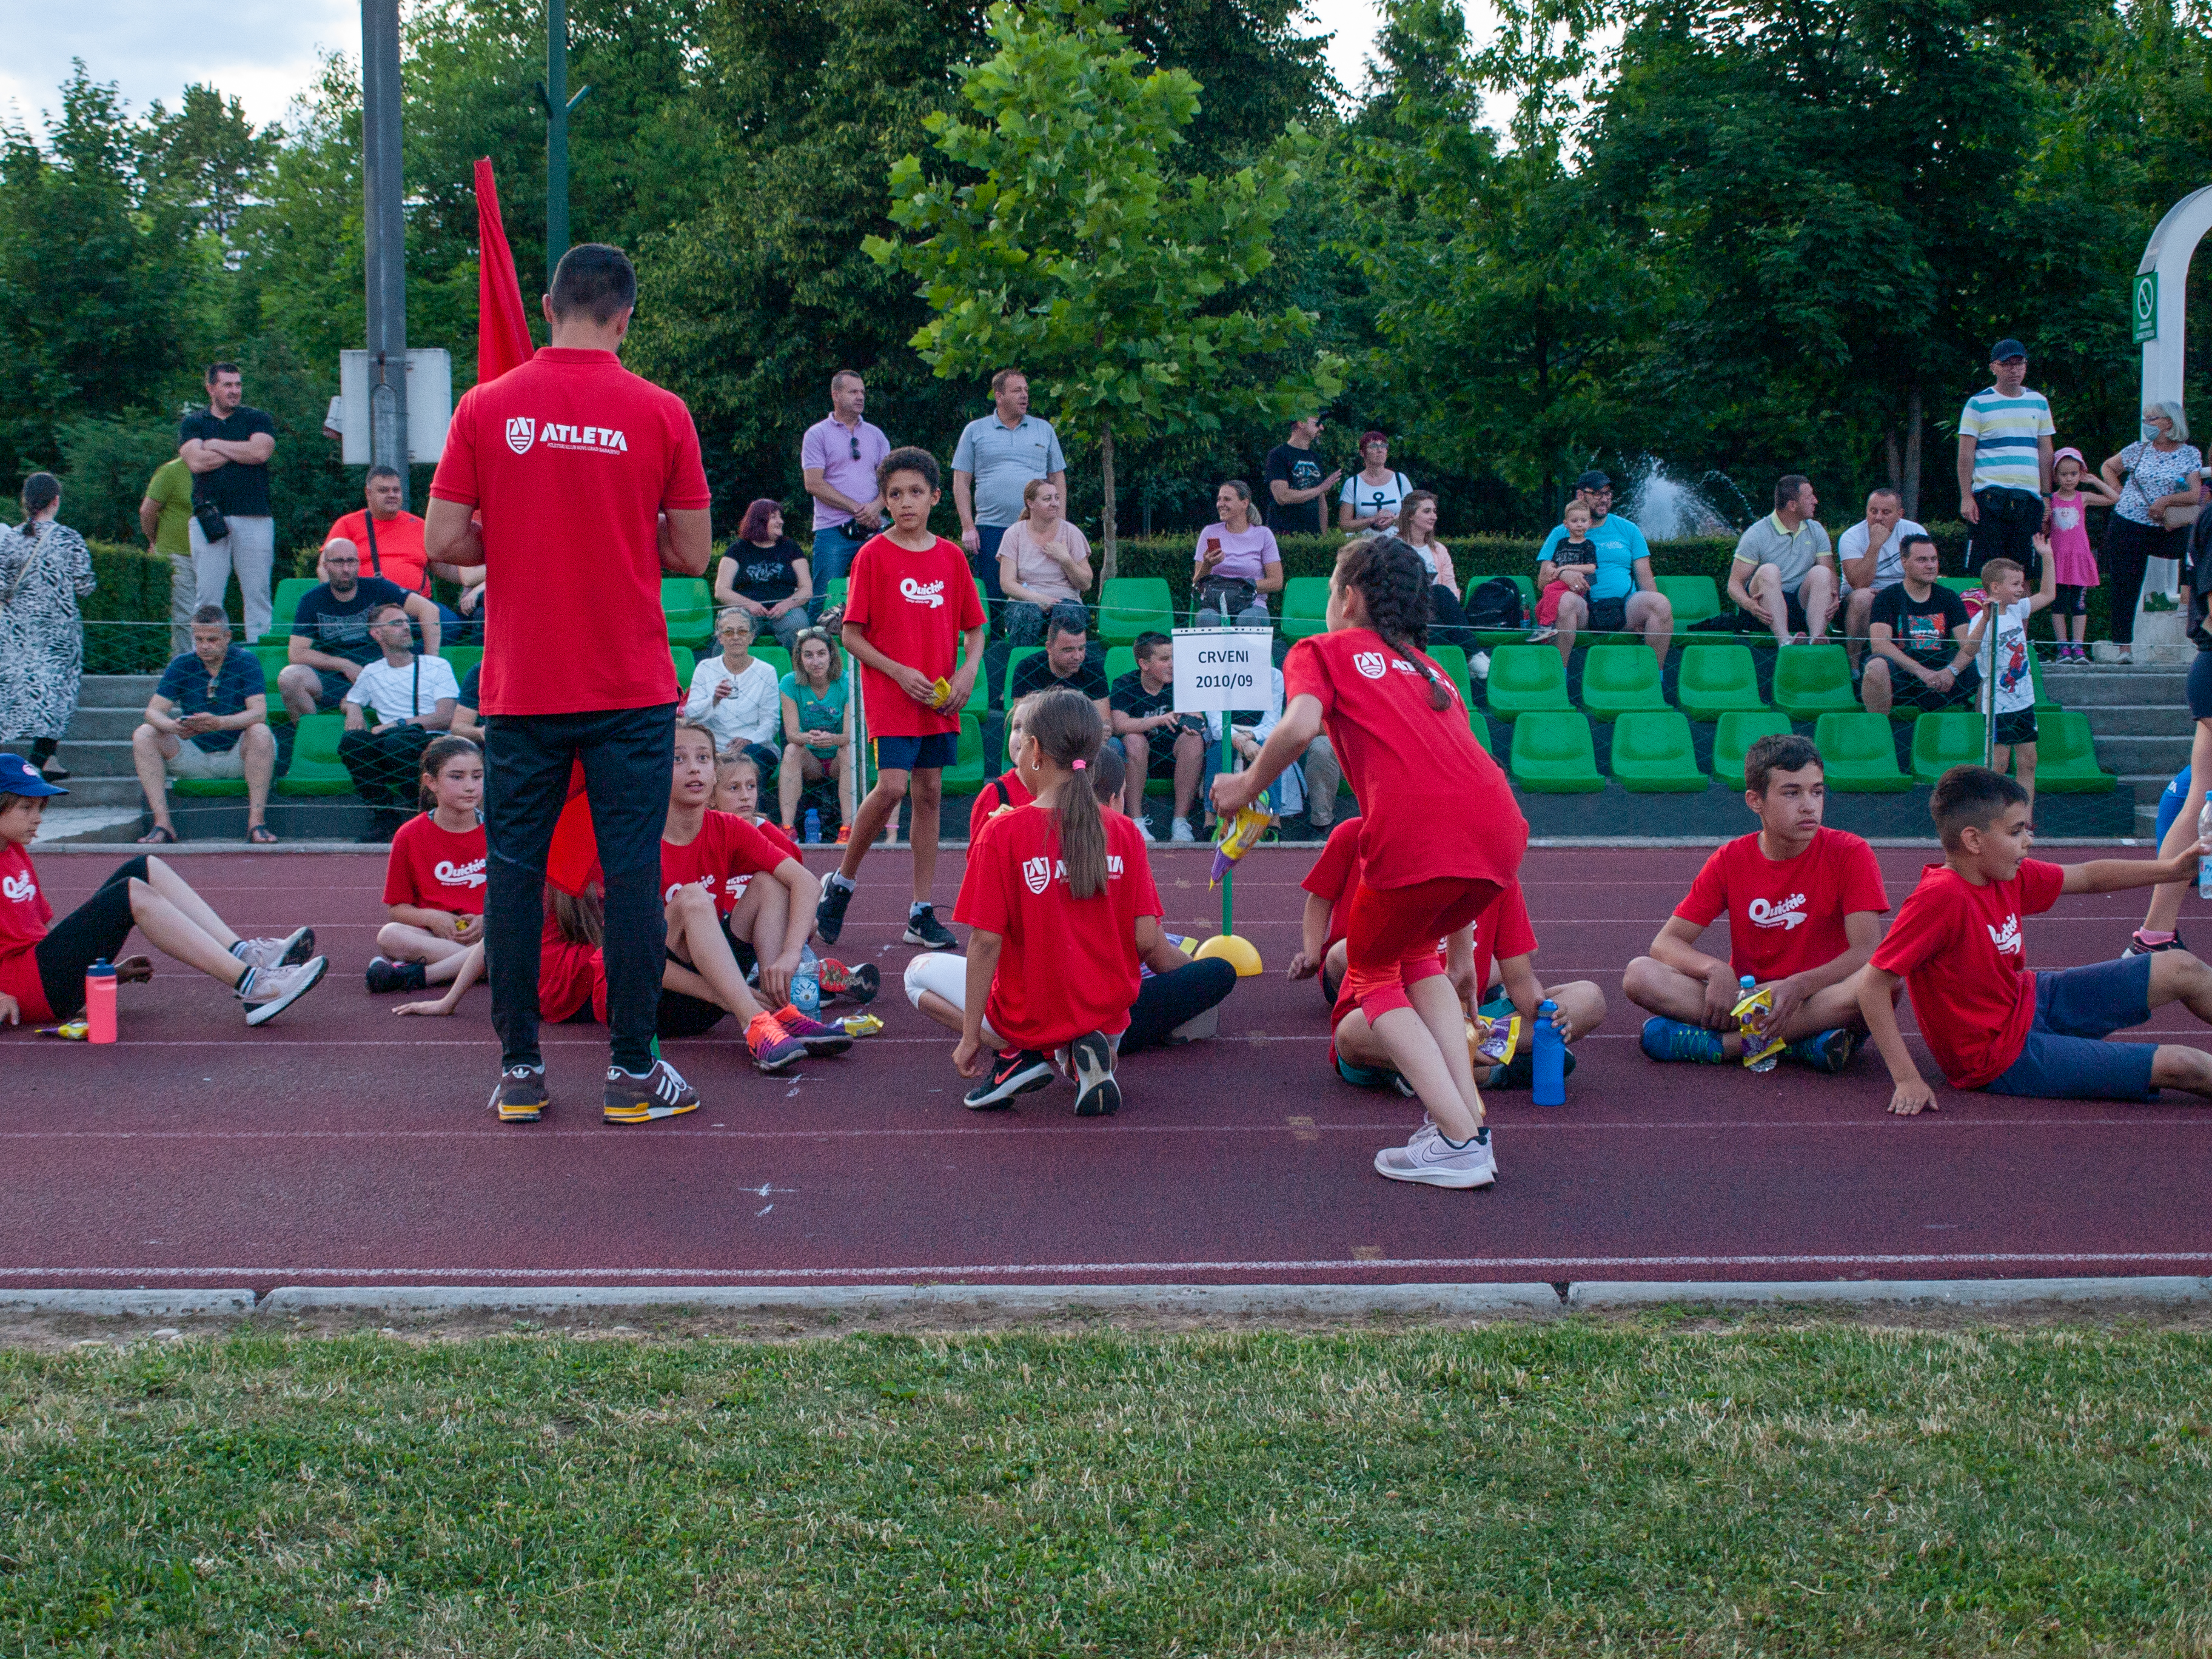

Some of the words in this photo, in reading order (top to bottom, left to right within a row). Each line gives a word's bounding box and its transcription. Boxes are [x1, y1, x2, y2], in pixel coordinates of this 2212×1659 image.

[540, 423, 628, 452] ATLETA
[900, 578, 944, 608] Quickie
[1198, 650, 1249, 663] CRVENI
[1196, 673, 1253, 689] 2010/09
[434, 858, 486, 889] Quickie
[1749, 893, 1808, 931] Quickie
